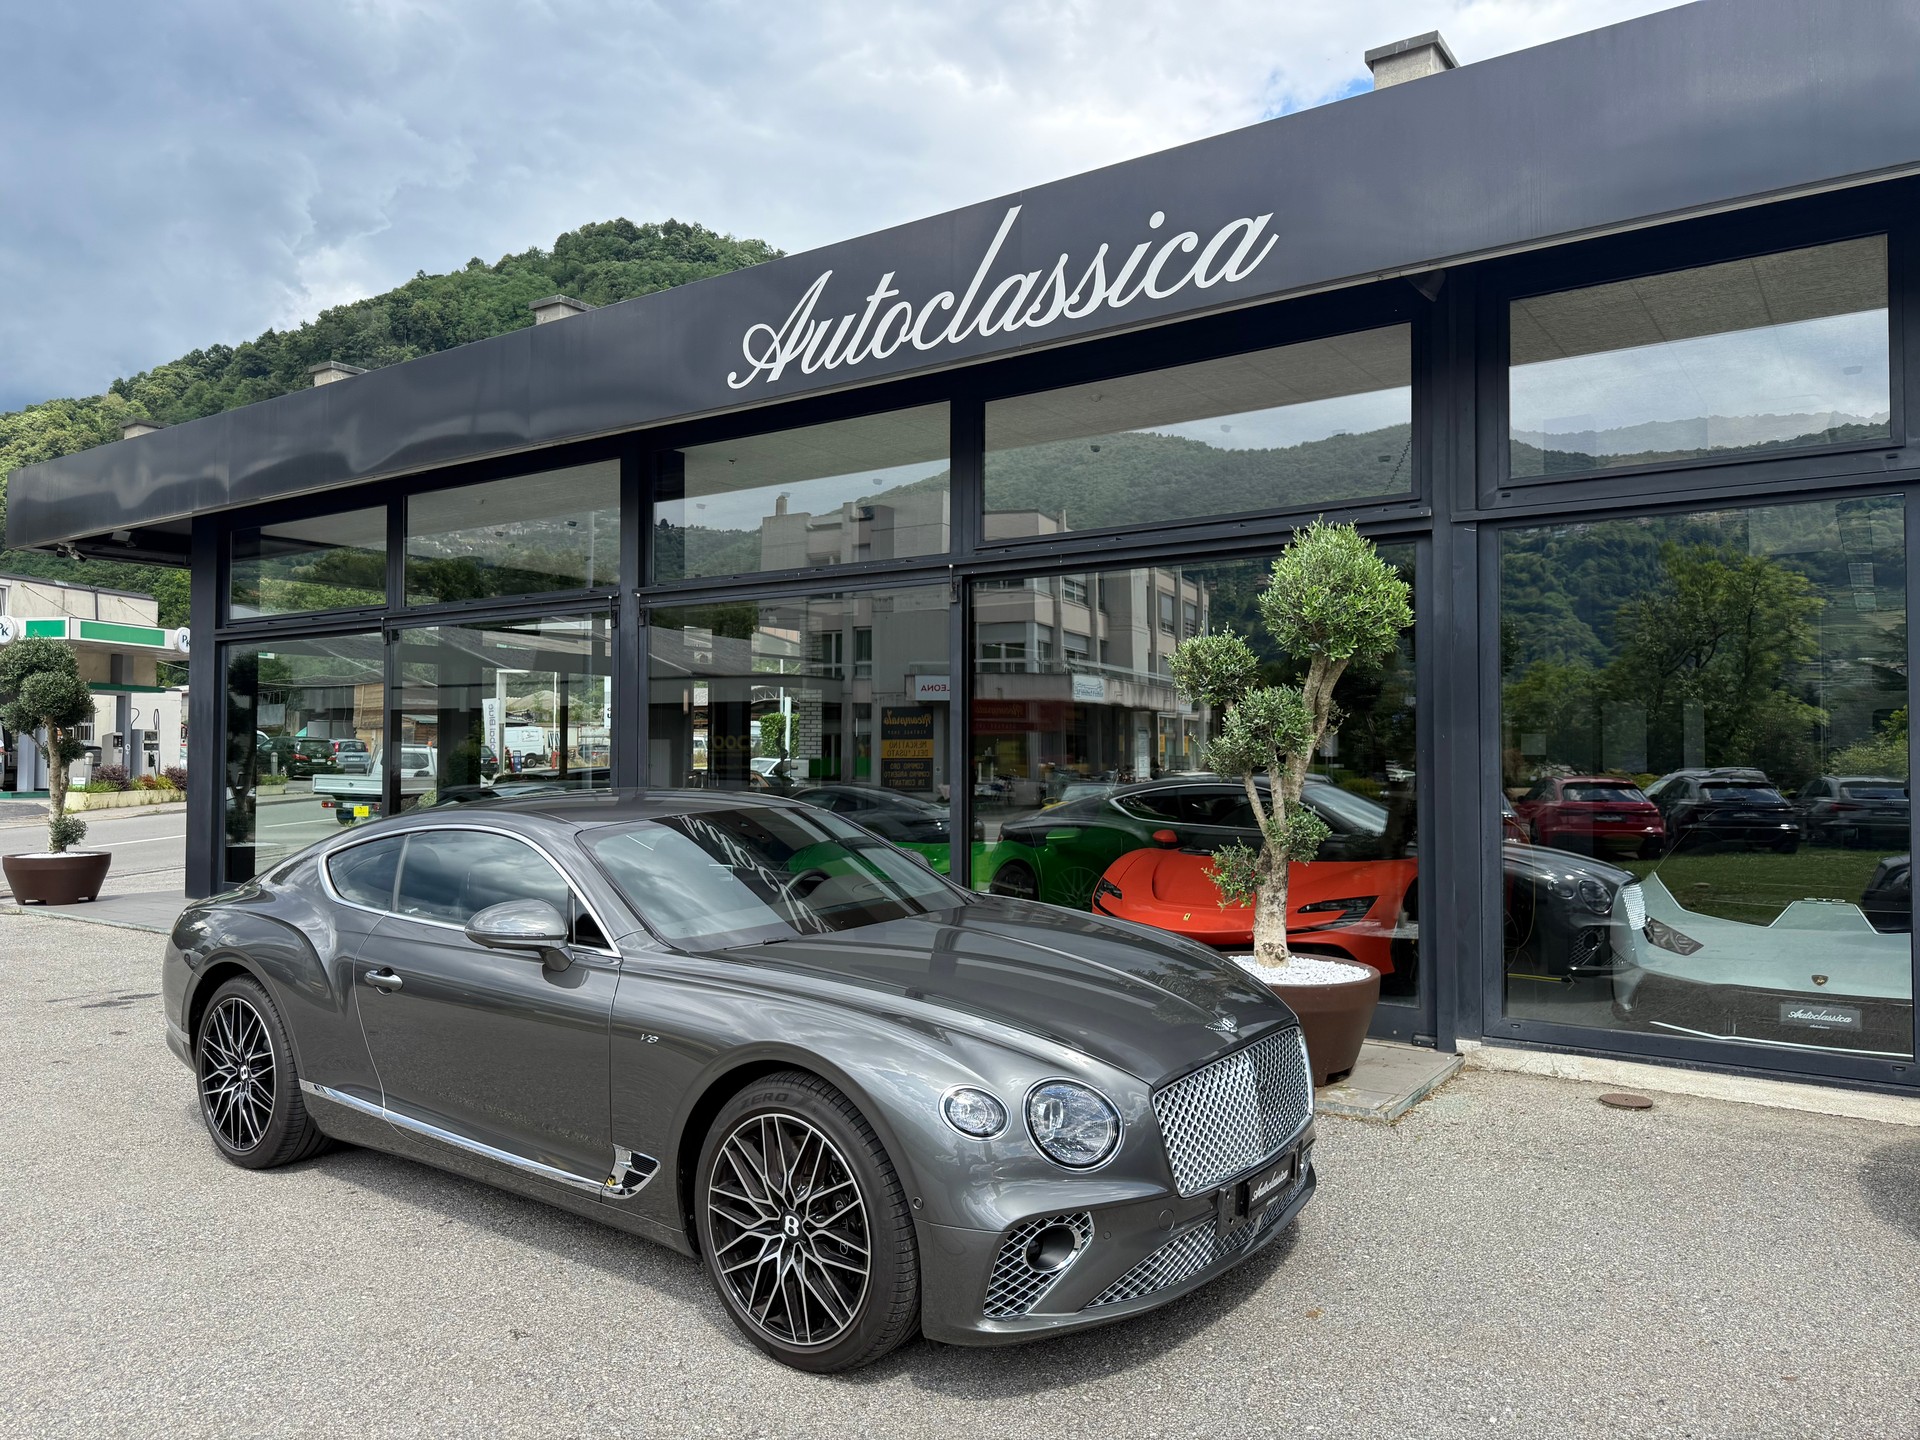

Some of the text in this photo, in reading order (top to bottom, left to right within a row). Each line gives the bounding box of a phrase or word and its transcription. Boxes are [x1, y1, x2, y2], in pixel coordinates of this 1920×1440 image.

[727, 204, 1280, 389] Autoclassica
[1788, 1009, 1853, 1023] Autoclassica
[640, 1033, 659, 1044] V8
[740, 1092, 789, 1110] ZERO
[1251, 1169, 1289, 1202] Autoclassica
[784, 1215, 800, 1237] B
